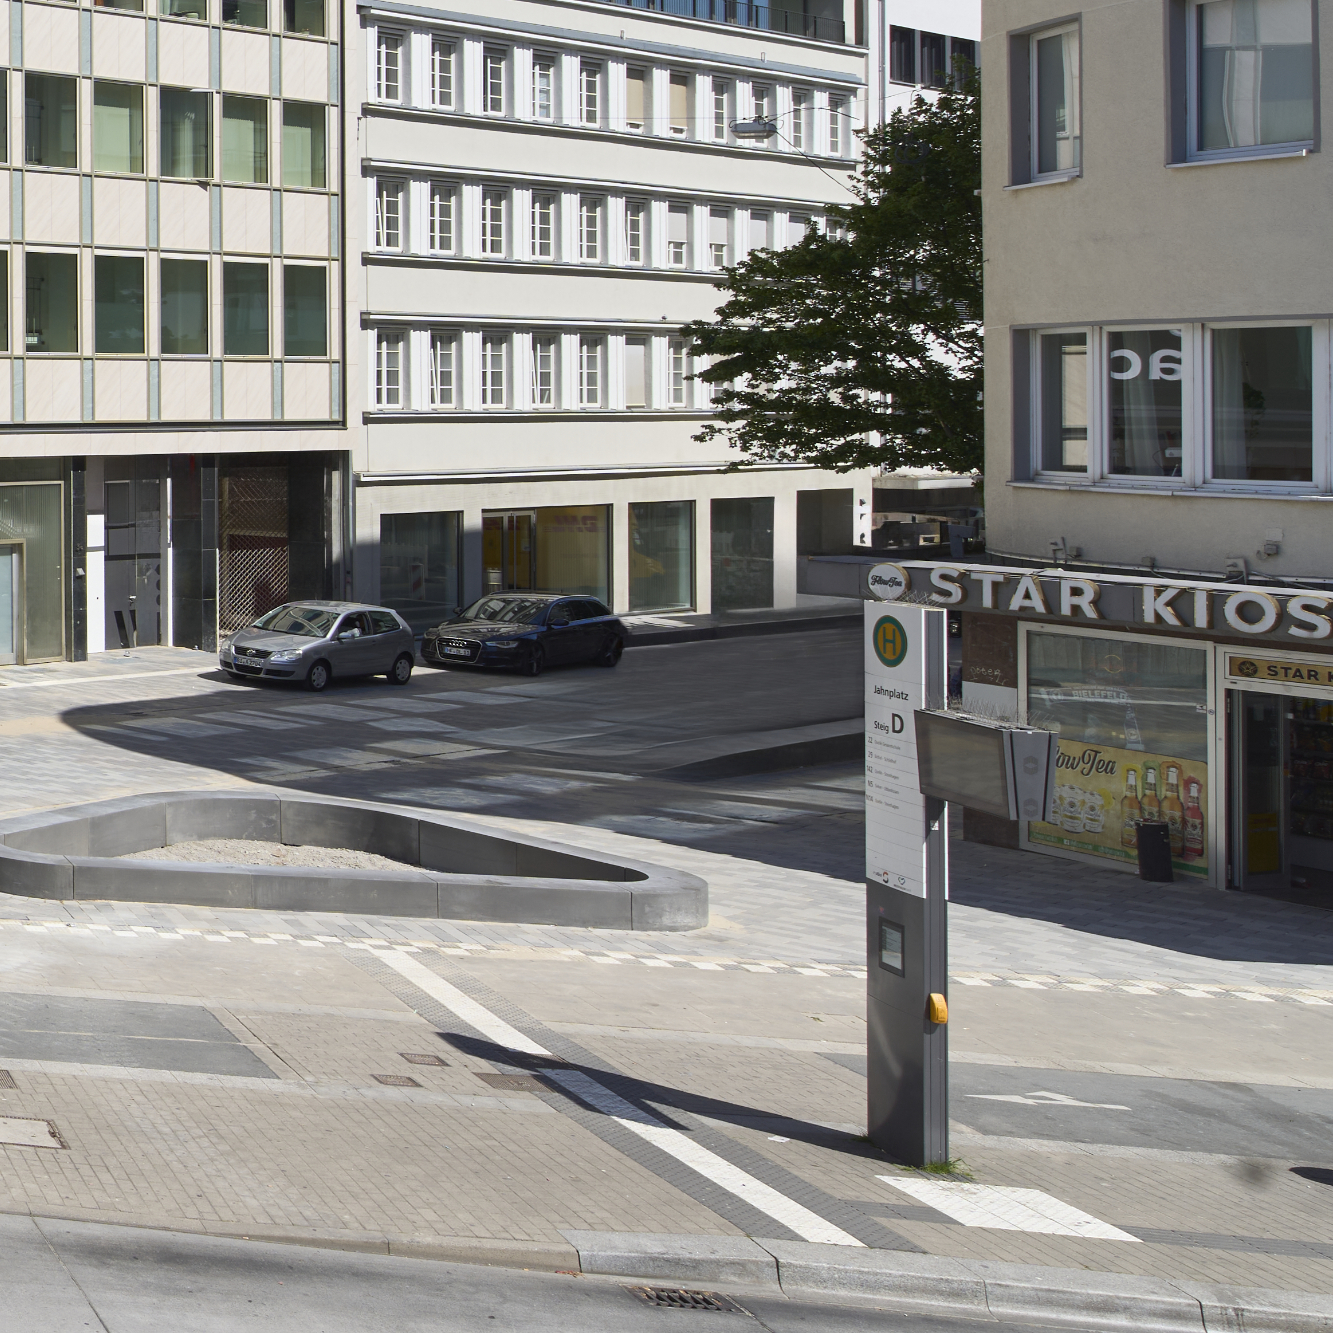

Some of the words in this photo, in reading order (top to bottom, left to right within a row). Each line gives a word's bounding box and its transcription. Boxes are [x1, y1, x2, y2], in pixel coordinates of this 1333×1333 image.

[929, 566, 1103, 620] STAR
[1266, 665, 1320, 682] STAR
[873, 685, 909, 701] Jahnplatz
[1072, 690, 1127, 701] BIELEFELD
[874, 720, 889, 734] Steig
[892, 713, 904, 734] D
